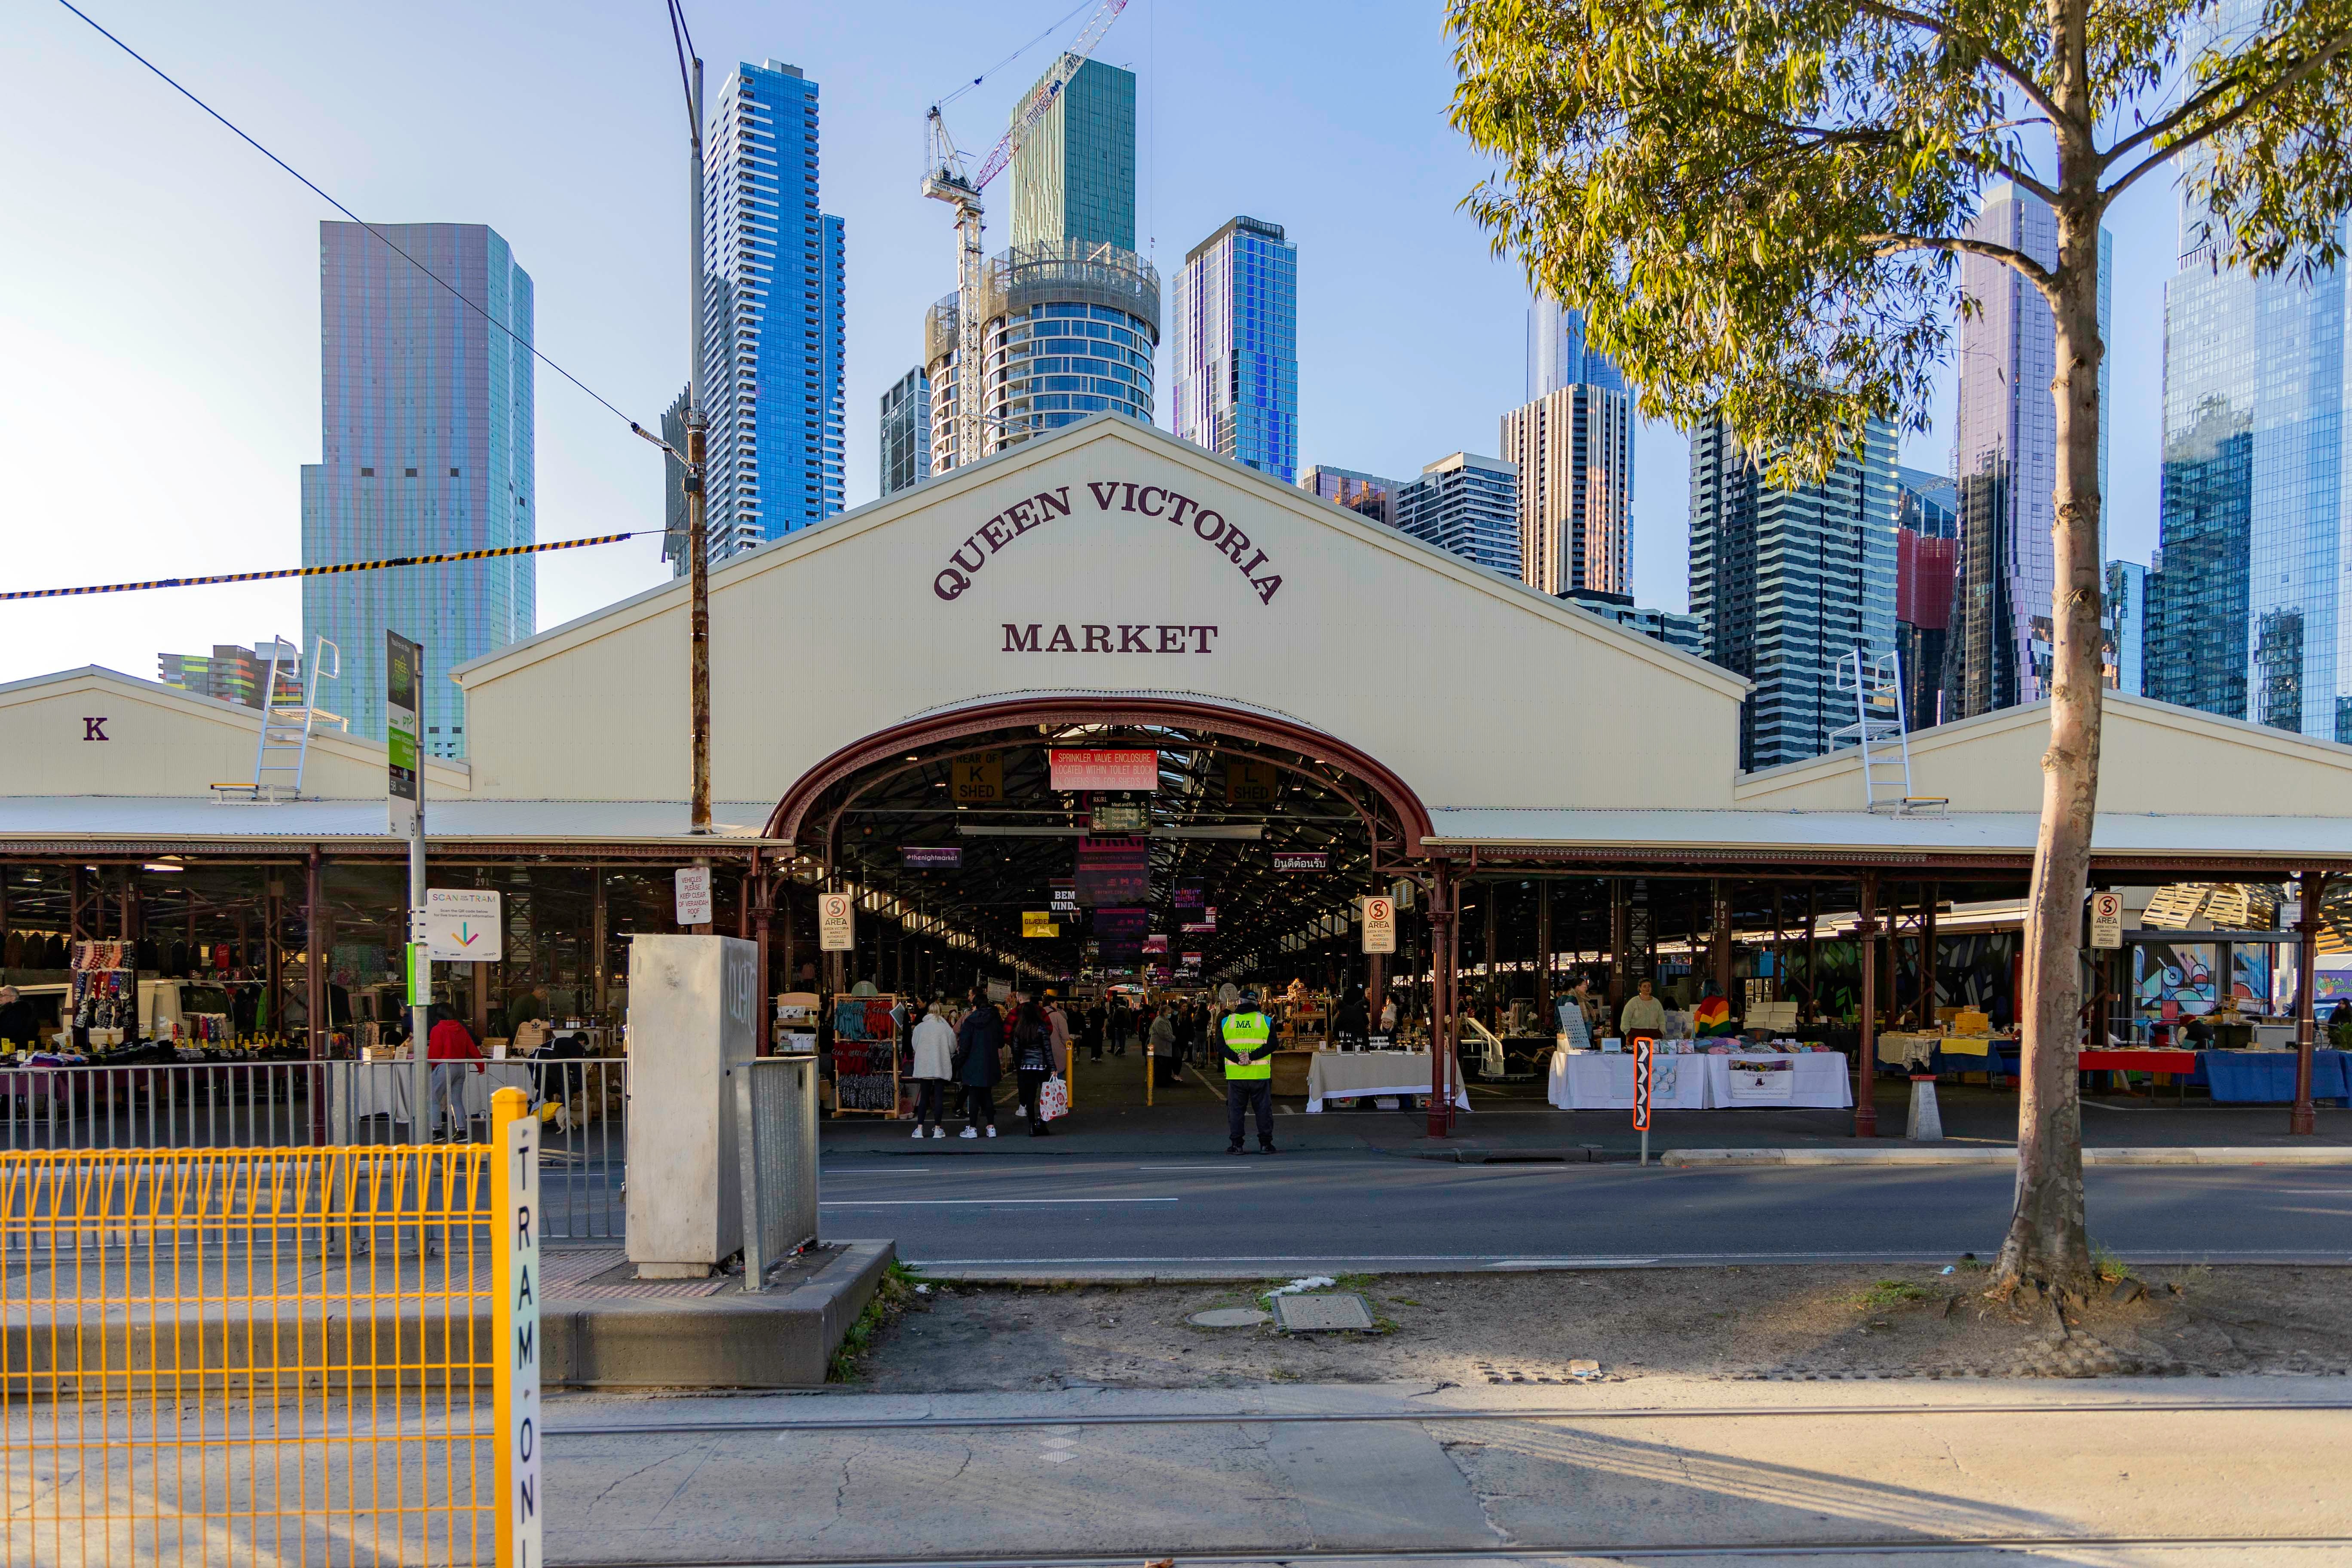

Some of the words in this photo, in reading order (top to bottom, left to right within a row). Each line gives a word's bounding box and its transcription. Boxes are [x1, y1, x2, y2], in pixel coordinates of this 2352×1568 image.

[1026, 91, 1053, 126] mirvac
[934, 486, 1071, 601] QUEEN
[1087, 481, 1283, 606] VICTORIA
[1001, 624, 1218, 653] MARKET
[395, 658, 407, 674] FREE
[395, 670, 407, 681] TRAM
[83, 717, 109, 741] K
[956, 753, 980, 763] REAR
[986, 753, 997, 763] OF
[1058, 753, 1091, 763] SPRINKLER
[1094, 753, 1112, 763] VALVE
[1115, 753, 1151, 763] ENCLOSURE
[970, 766, 983, 782] K
[1055, 765, 1082, 775] LOCATED
[1086, 765, 1106, 775] WITHIN
[1109, 765, 1130, 775] TOILET
[1133, 765, 1153, 775] BLOCK
[1245, 766, 1259, 782] L
[390, 780, 397, 792] 58
[1055, 777, 1061, 786] IN
[1065, 777, 1089, 787] QUEENS
[1103, 777, 1115, 786] FOR
[1119, 777, 1140, 787] SHED'S
[1143, 777, 1153, 787] K/L
[960, 784, 994, 798] SHED
[1234, 786, 1268, 799] SHED
[411, 822, 415, 837] 9
[1274, 857, 1326, 868] ยินดีต้อนรับ
[477, 867, 484, 876] P
[1055, 891, 1075, 900] BEM
[518, 1146, 533, 1370] TRAM
